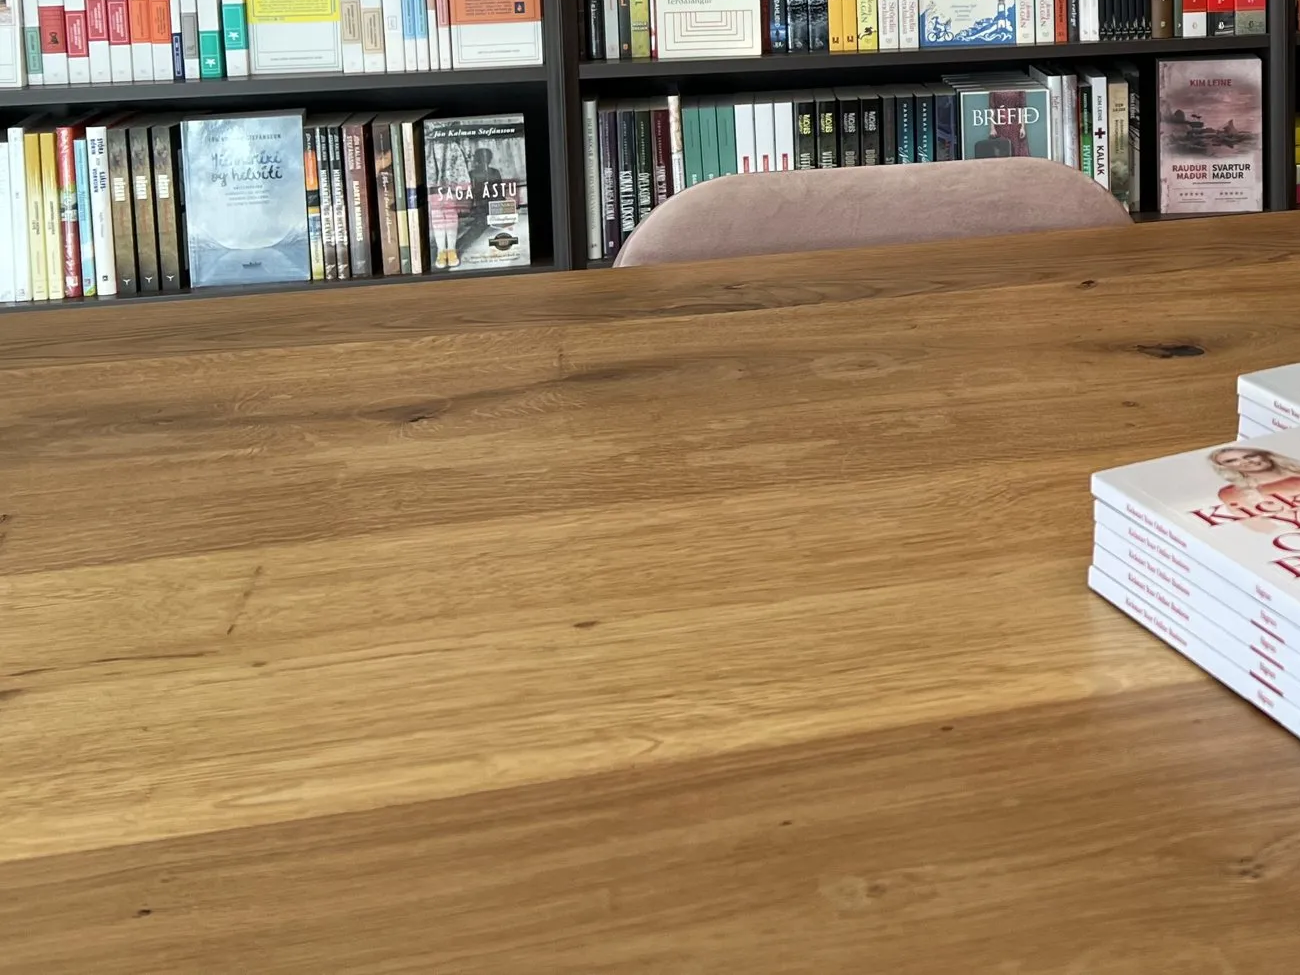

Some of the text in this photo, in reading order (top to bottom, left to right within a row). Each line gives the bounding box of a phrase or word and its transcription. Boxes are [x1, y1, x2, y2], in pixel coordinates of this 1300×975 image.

[1190, 79, 1233, 87] KIM LEINE
[972, 105, 1040, 126] BRÉFIÐ
[434, 129, 447, 137] Jón
[478, 127, 515, 135] Stefánsson
[1096, 145, 1105, 176] KALAK
[1212, 164, 1251, 172] SVARTUR
[437, 182, 517, 201] SAGA ÁSTU
